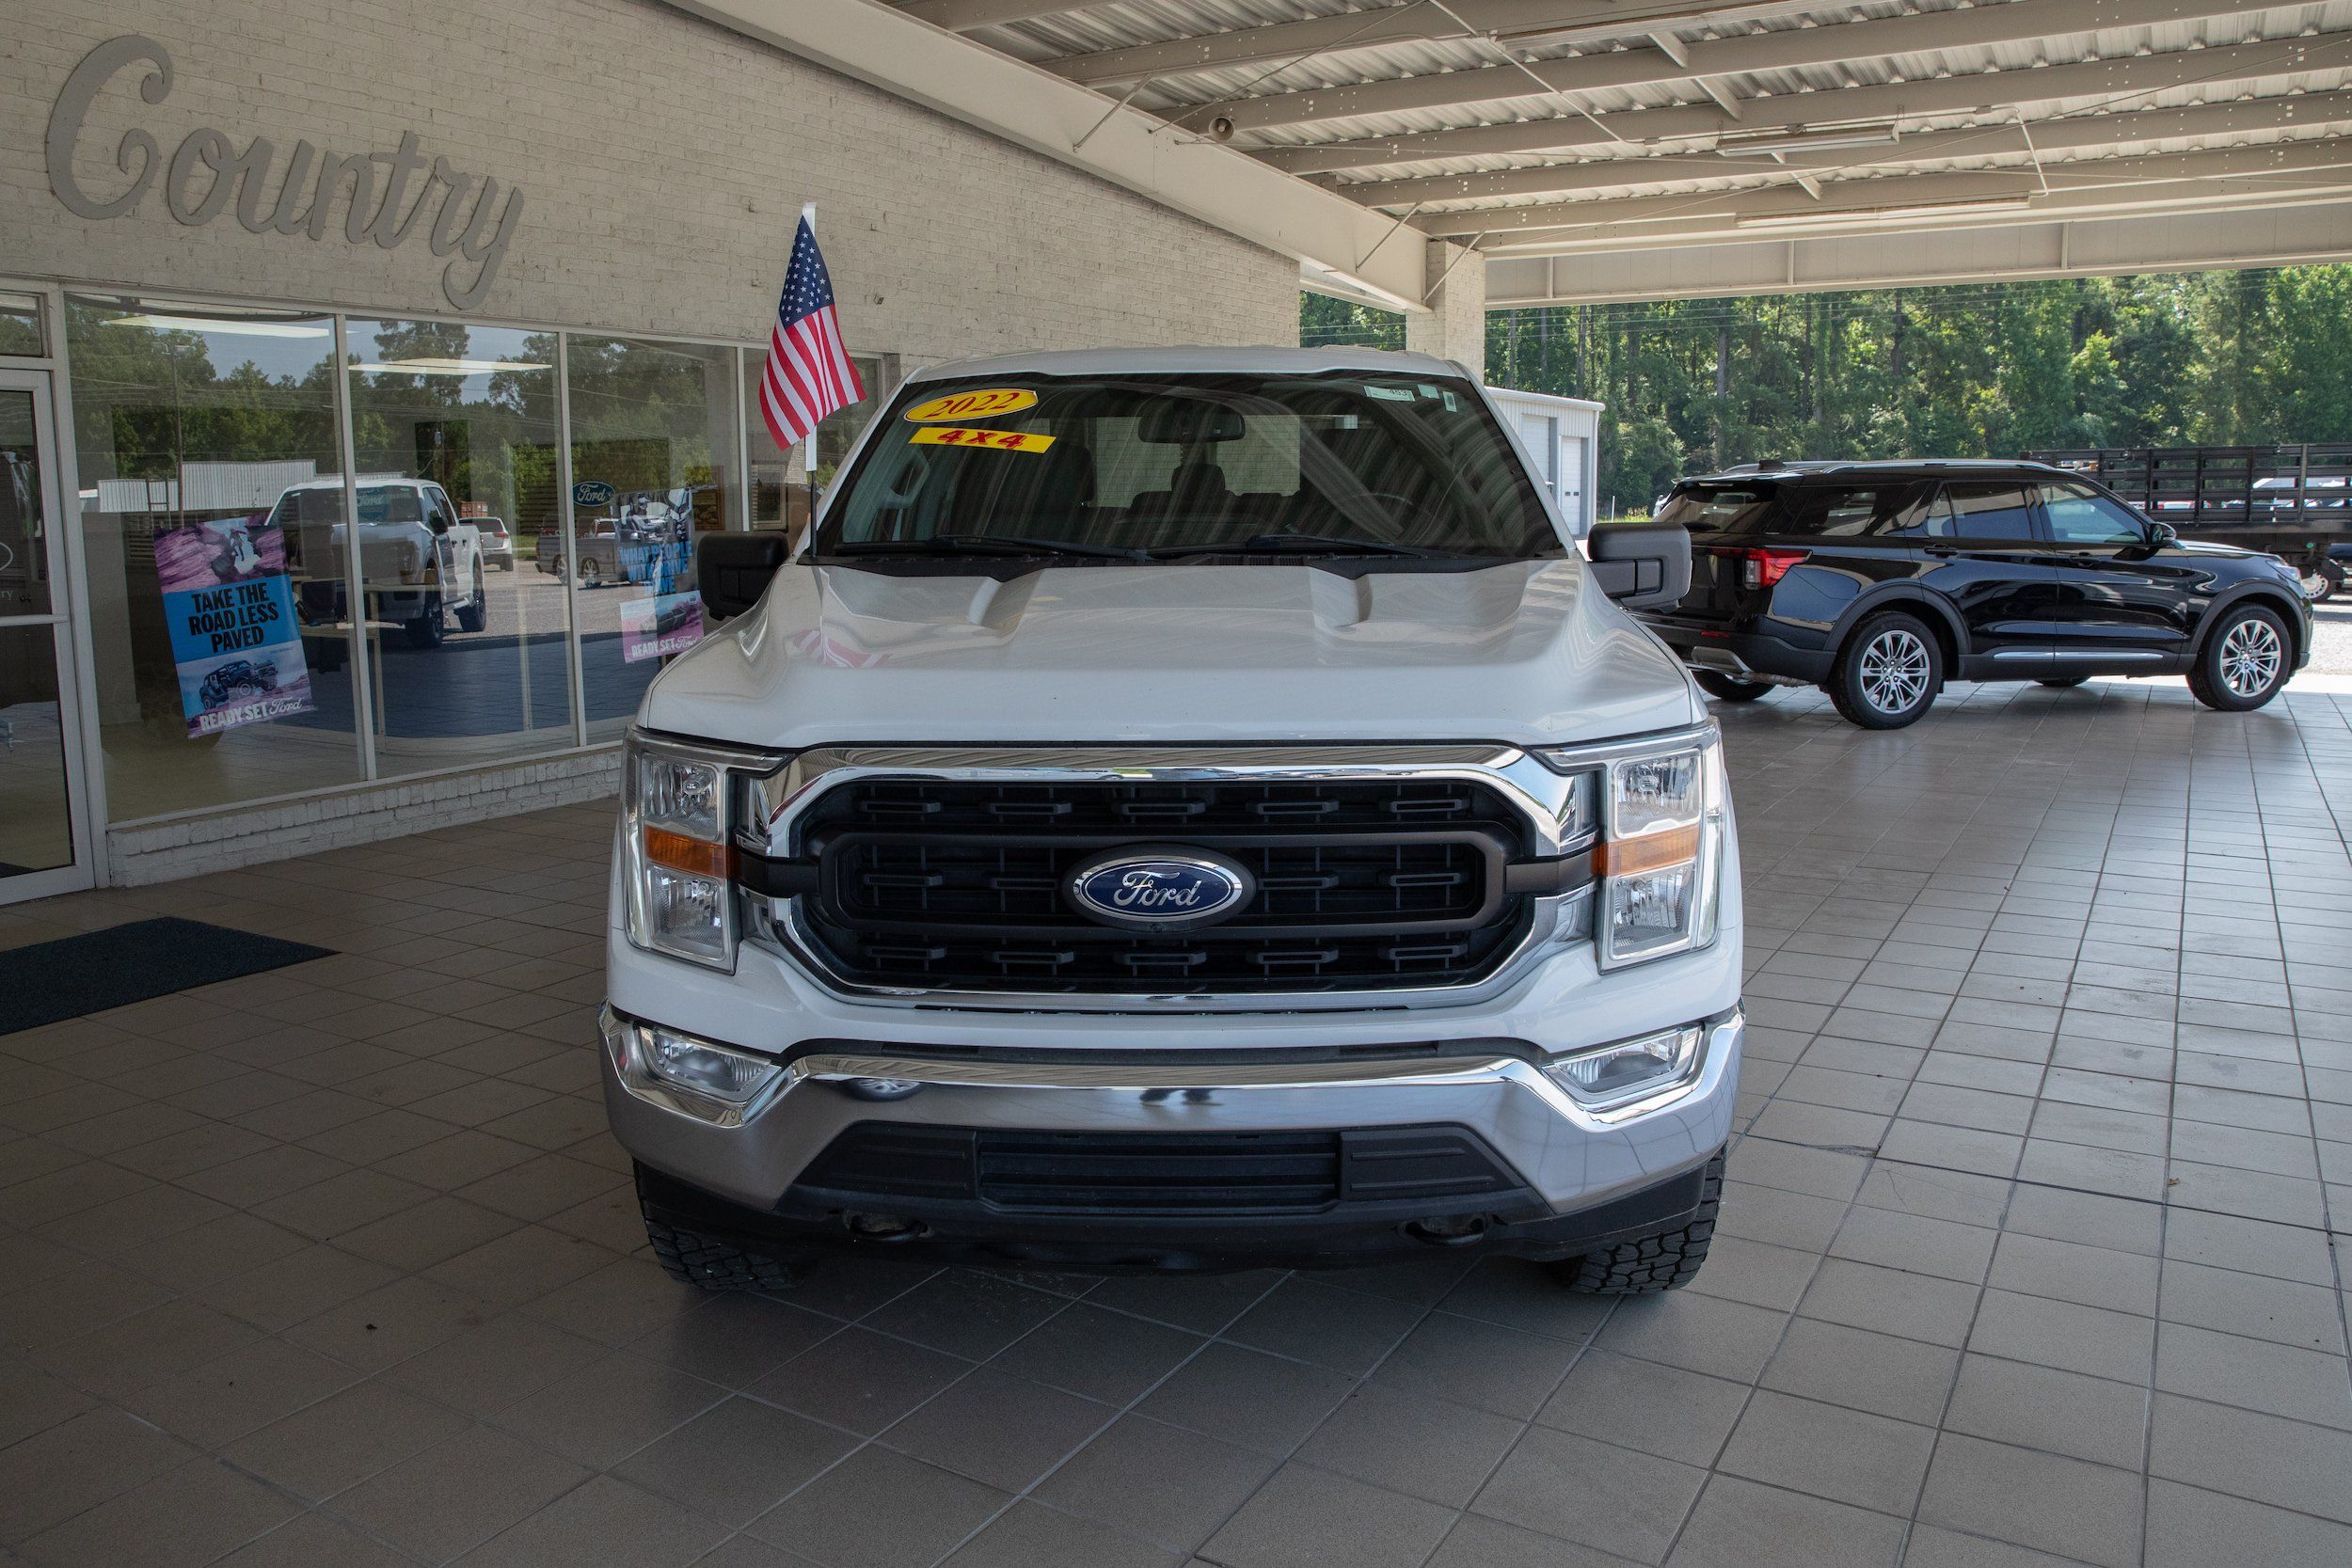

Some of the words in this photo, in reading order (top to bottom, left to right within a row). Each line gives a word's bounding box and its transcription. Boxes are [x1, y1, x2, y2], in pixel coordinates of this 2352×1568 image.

[46, 35, 525, 309] Country
[924, 392, 1020, 418] 2022
[577, 484, 606, 501] Ford
[191, 588, 235, 613] TAKE
[236, 582, 269, 605] THE
[189, 610, 236, 635] ROAD
[238, 602, 279, 626] LESS
[211, 626, 263, 653] PAVED
[269, 697, 303, 715] Ford
[1114, 871, 1200, 906] Ford
